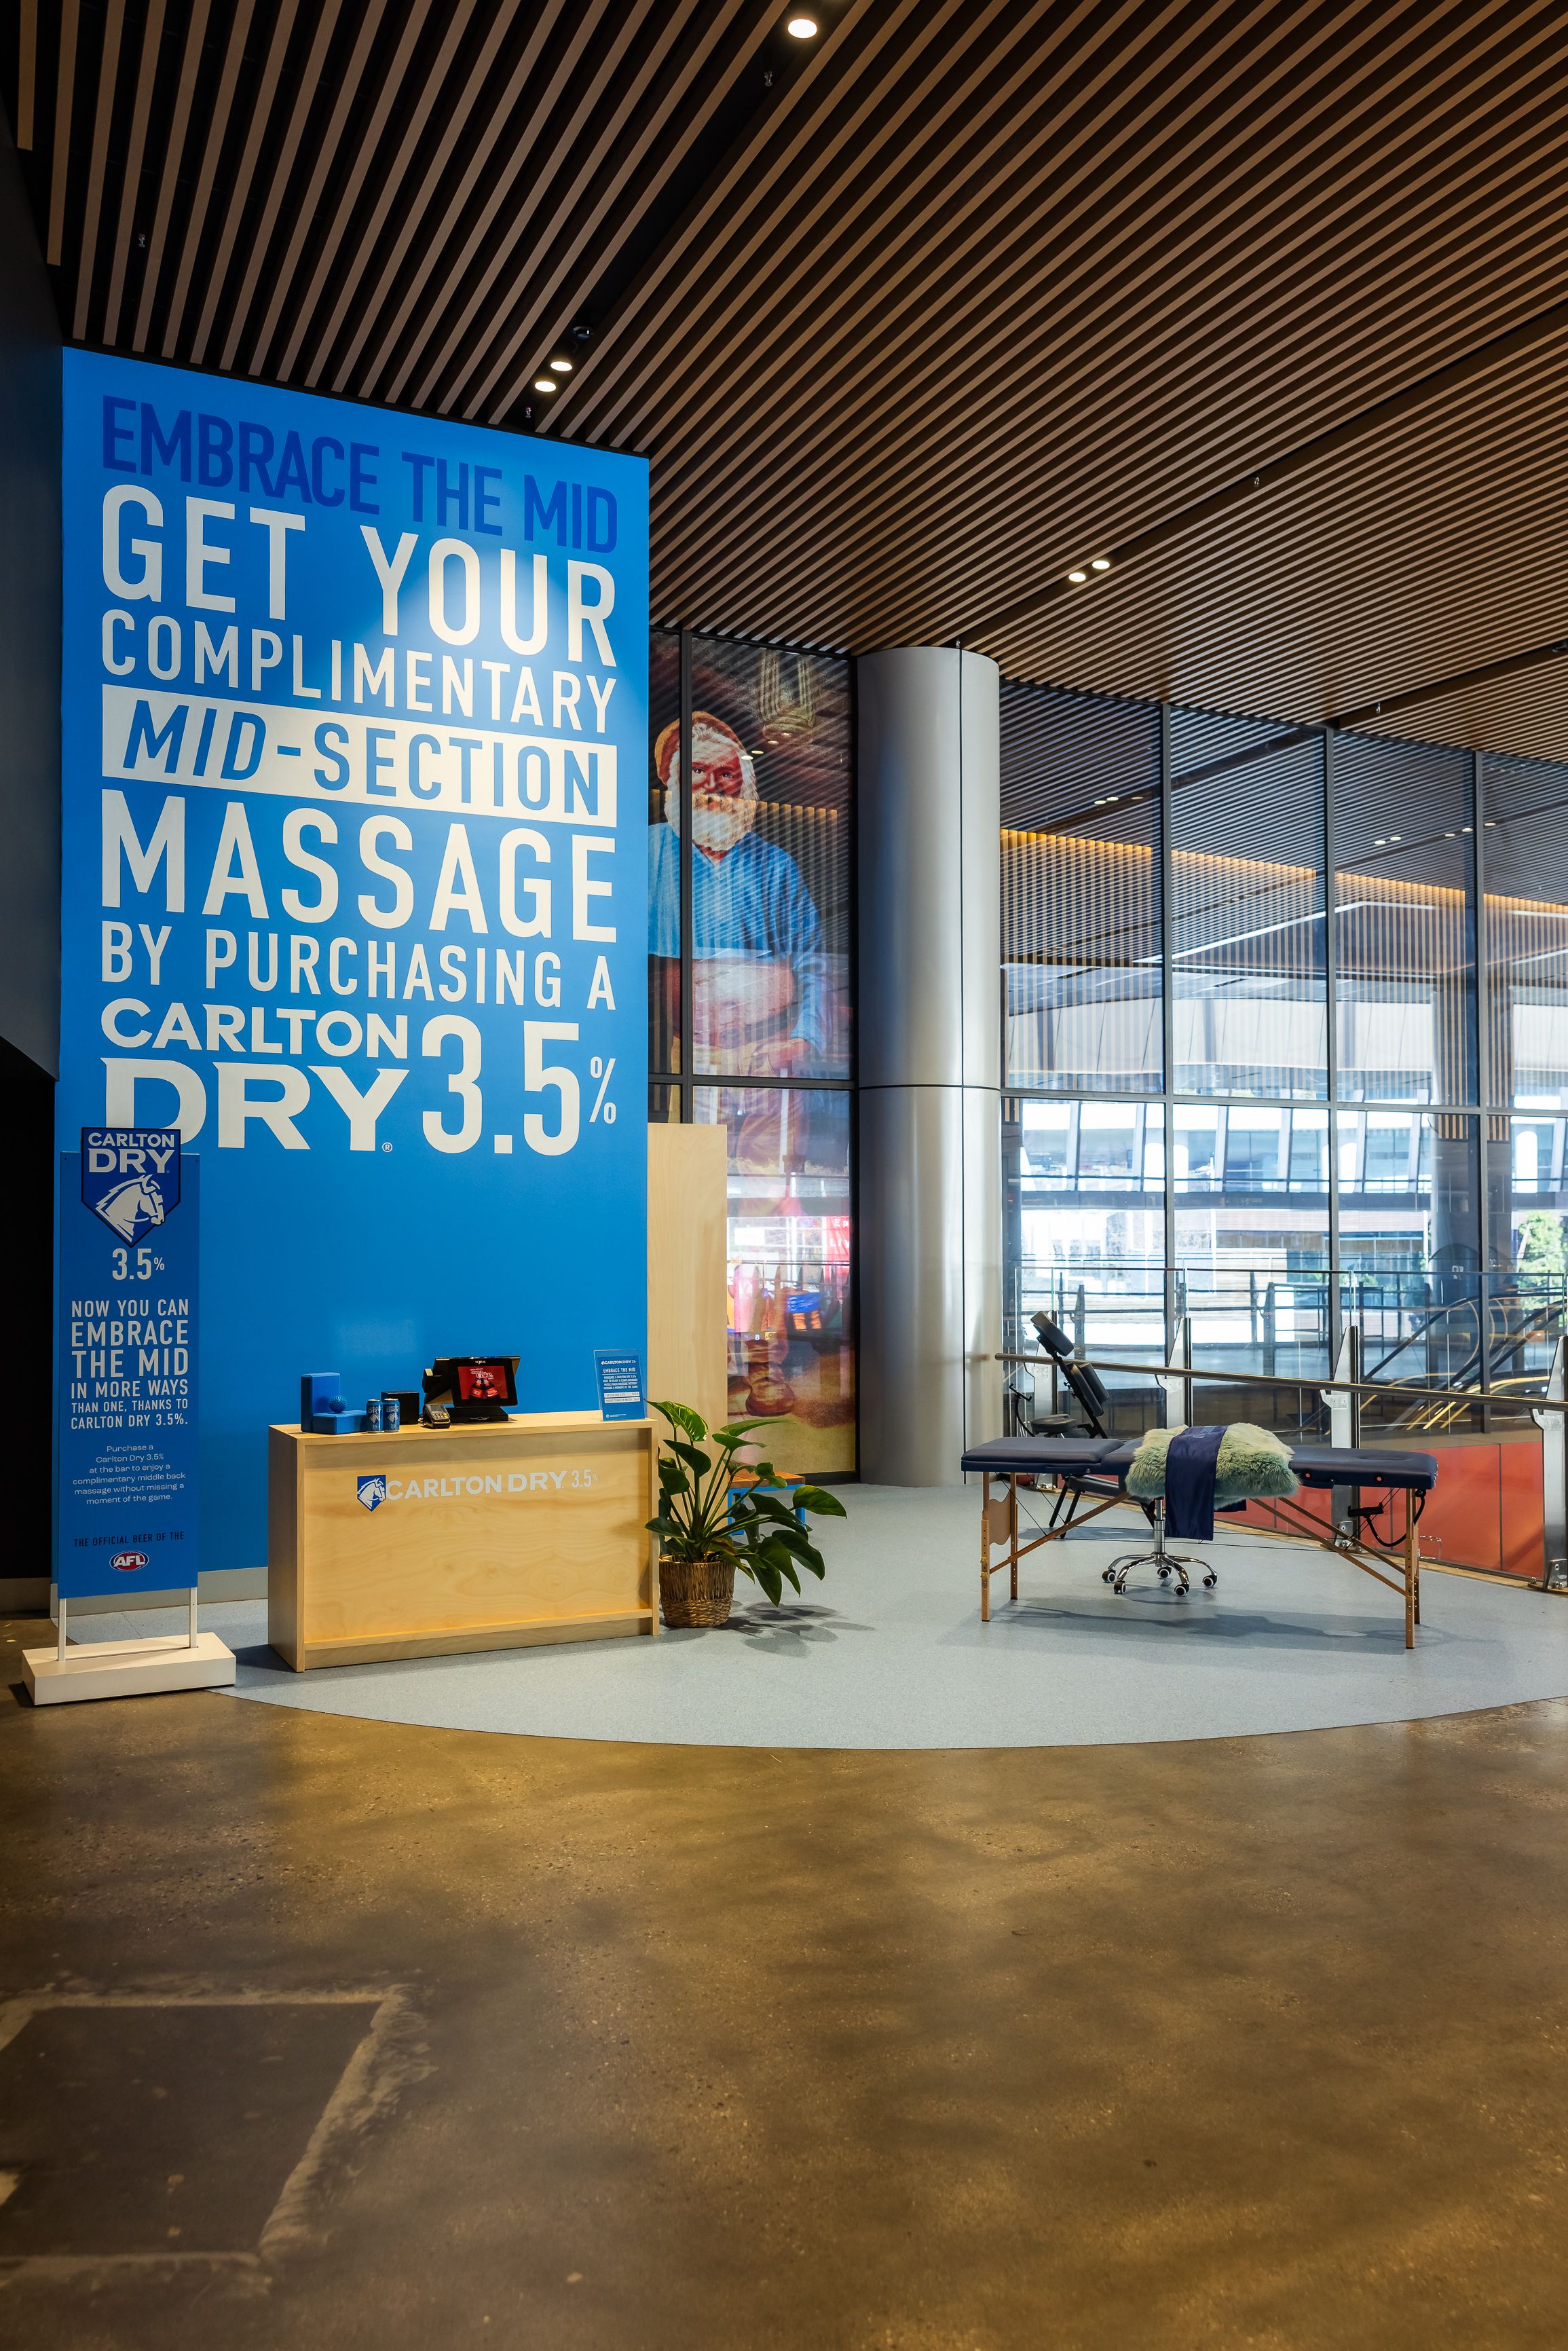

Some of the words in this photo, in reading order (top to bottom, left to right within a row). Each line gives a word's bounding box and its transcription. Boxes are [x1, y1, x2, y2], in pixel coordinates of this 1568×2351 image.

[103, 394, 380, 515] EMBRACE
[402, 451, 502, 536] THE
[524, 475, 618, 553] MID
[102, 484, 305, 621] GET
[360, 525, 617, 667] YOUR
[102, 609, 616, 733] COMPLIMENTARY
[122, 699, 599, 816] MID-SECTION
[102, 789, 617, 943] MASSAGE
[102, 921, 172, 985] BY
[206, 929, 561, 1008] PURCHASING
[586, 955, 616, 1010] A
[101, 998, 408, 1059] CARLTON
[89, 1133, 174, 1147] CARLTON
[88, 1148, 174, 1174] DRY
[113, 1248, 164, 1280] 3.5%
[71, 1300, 109, 1317] NOW
[117, 1299, 149, 1317] YOU
[157, 1299, 189, 1316] CAN
[71, 1319, 189, 1347] EMBRACE
[71, 1350, 124, 1379] THE
[138, 1348, 189, 1377] MID
[71, 1382, 87, 1399] IN
[96, 1380, 141, 1398] MORE
[147, 1379, 188, 1396] WAYS
[71, 1402, 98, 1413] THAN
[103, 1401, 127, 1412] ONE,
[132, 1399, 172, 1411] THANKS
[176, 1399, 188, 1409] TO
[71, 1415, 123, 1430] CARLTON
[128, 1414, 151, 1427] DRY
[96, 1455, 128, 1463] Carlton
[107, 1445, 147, 1453] Purchase
[73, 1475, 136, 1485] complimentary
[137, 1473, 165, 1481] middle
[142, 1464, 164, 1473] enjoy
[74, 1487, 111, 1496] massage
[113, 1485, 145, 1493] without
[147, 1483, 178, 1492] missing
[385, 1475, 502, 1500] CARLTON
[508, 1471, 567, 1492] DRY
[73, 1538, 89, 1547] THE
[92, 1536, 129, 1546] OFFICIAL
[132, 1534, 153, 1543] BEER
[156, 1532, 166, 1541] OF
[170, 1531, 185, 1540] THE
[113, 1555, 145, 1568] AFL
